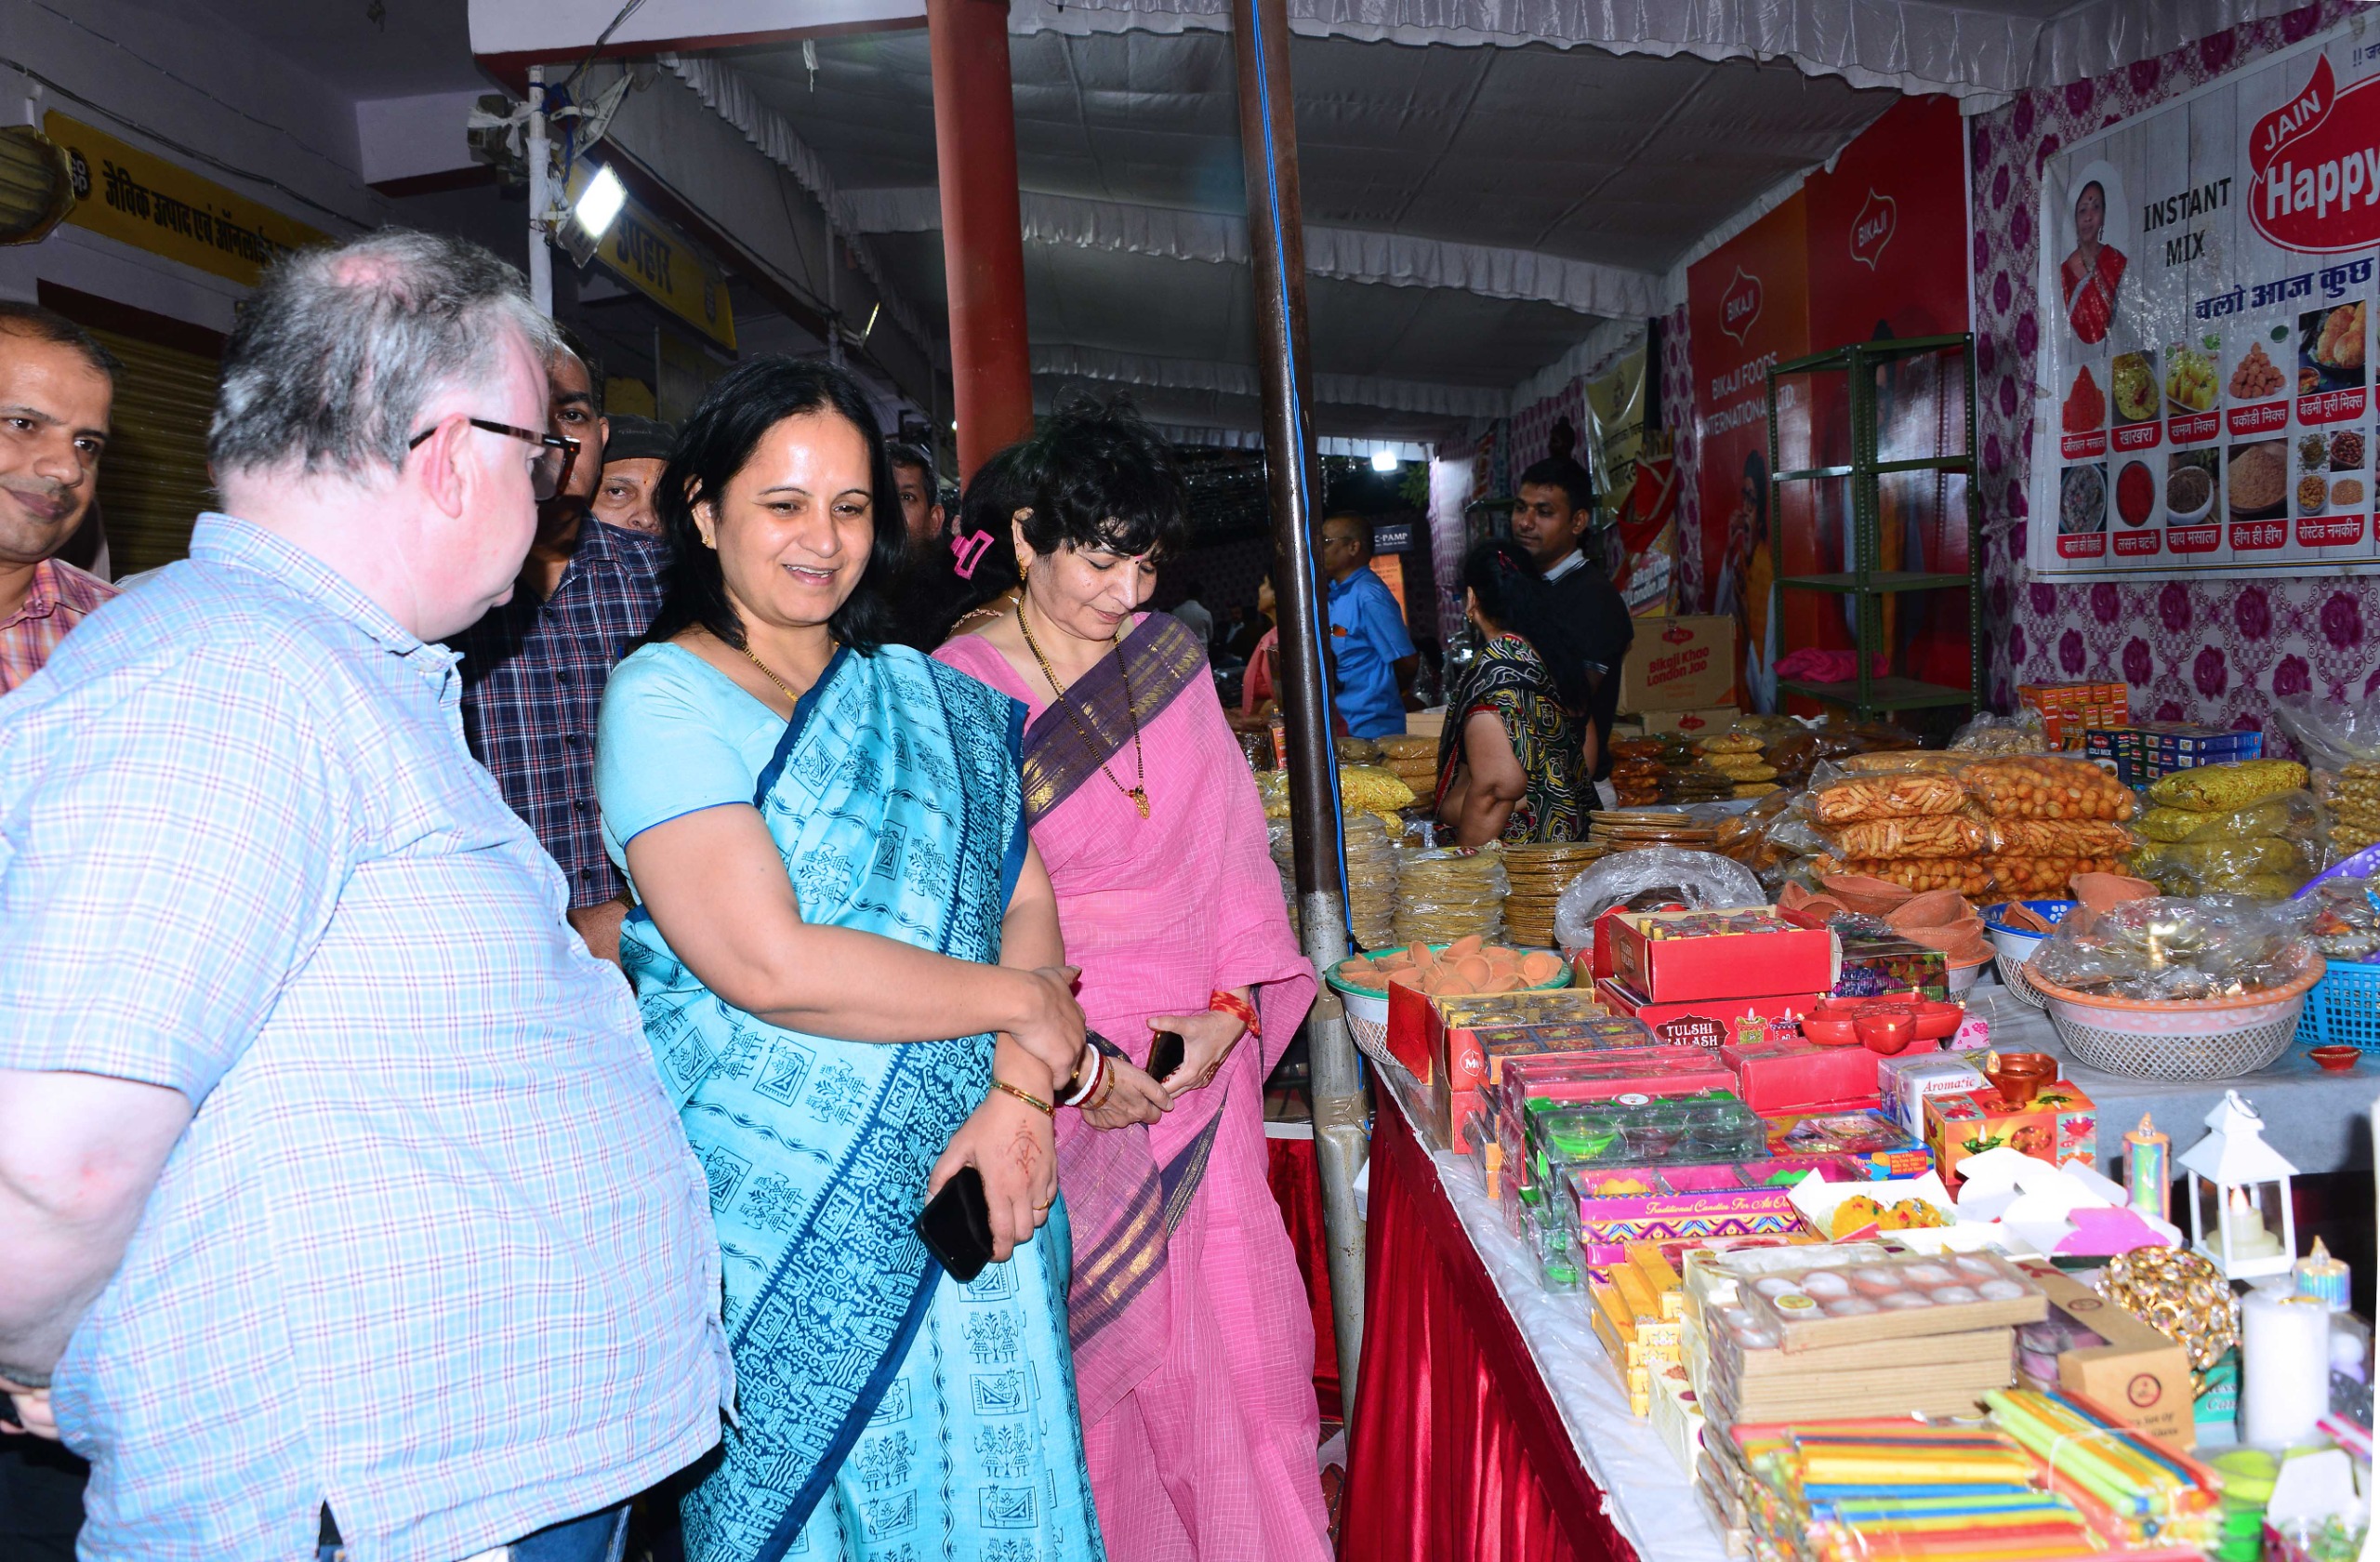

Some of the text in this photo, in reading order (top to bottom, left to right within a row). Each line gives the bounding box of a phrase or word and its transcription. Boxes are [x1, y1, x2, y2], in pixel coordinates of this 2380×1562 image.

[2264, 90, 2320, 152] JAIN
[2267, 147, 2380, 220] Happy
[102, 159, 151, 220] जैविक
[151, 191, 192, 237] उत्पाद
[192, 204, 214, 245] एवं
[2144, 177, 2231, 232] INSTANT
[616, 213, 673, 295] उपहार
[2165, 230, 2206, 267] MIX
[2195, 258, 2374, 320] चलो आज कुछ
[1727, 290, 1754, 322] BIKAJI
[1712, 373, 1740, 400] BIKAJI
[2262, 407, 2286, 424] मिक्स
[2323, 393, 2338, 417] पूरी
[2339, 392, 2363, 410] मिक्स
[2120, 427, 2153, 445] खाखरा
[2193, 417, 2216, 434] मिक्स
[2168, 530, 2216, 545] चाय मसाला
[2234, 524, 2282, 546] हींग ही हींग
[2298, 521, 2325, 539] रोस्टेड
[2327, 518, 2360, 538] नमकीन
[2118, 537, 2137, 550] लसन
[1649, 646, 1710, 673] Bikaji Khao
[1647, 660, 1707, 686] London Jao
[1666, 1023, 1713, 1037] TULSHI
[1646, 1202, 1693, 1215] Traditional
[1694, 1199, 1730, 1213] Candles
[1731, 1197, 1750, 1211] For
